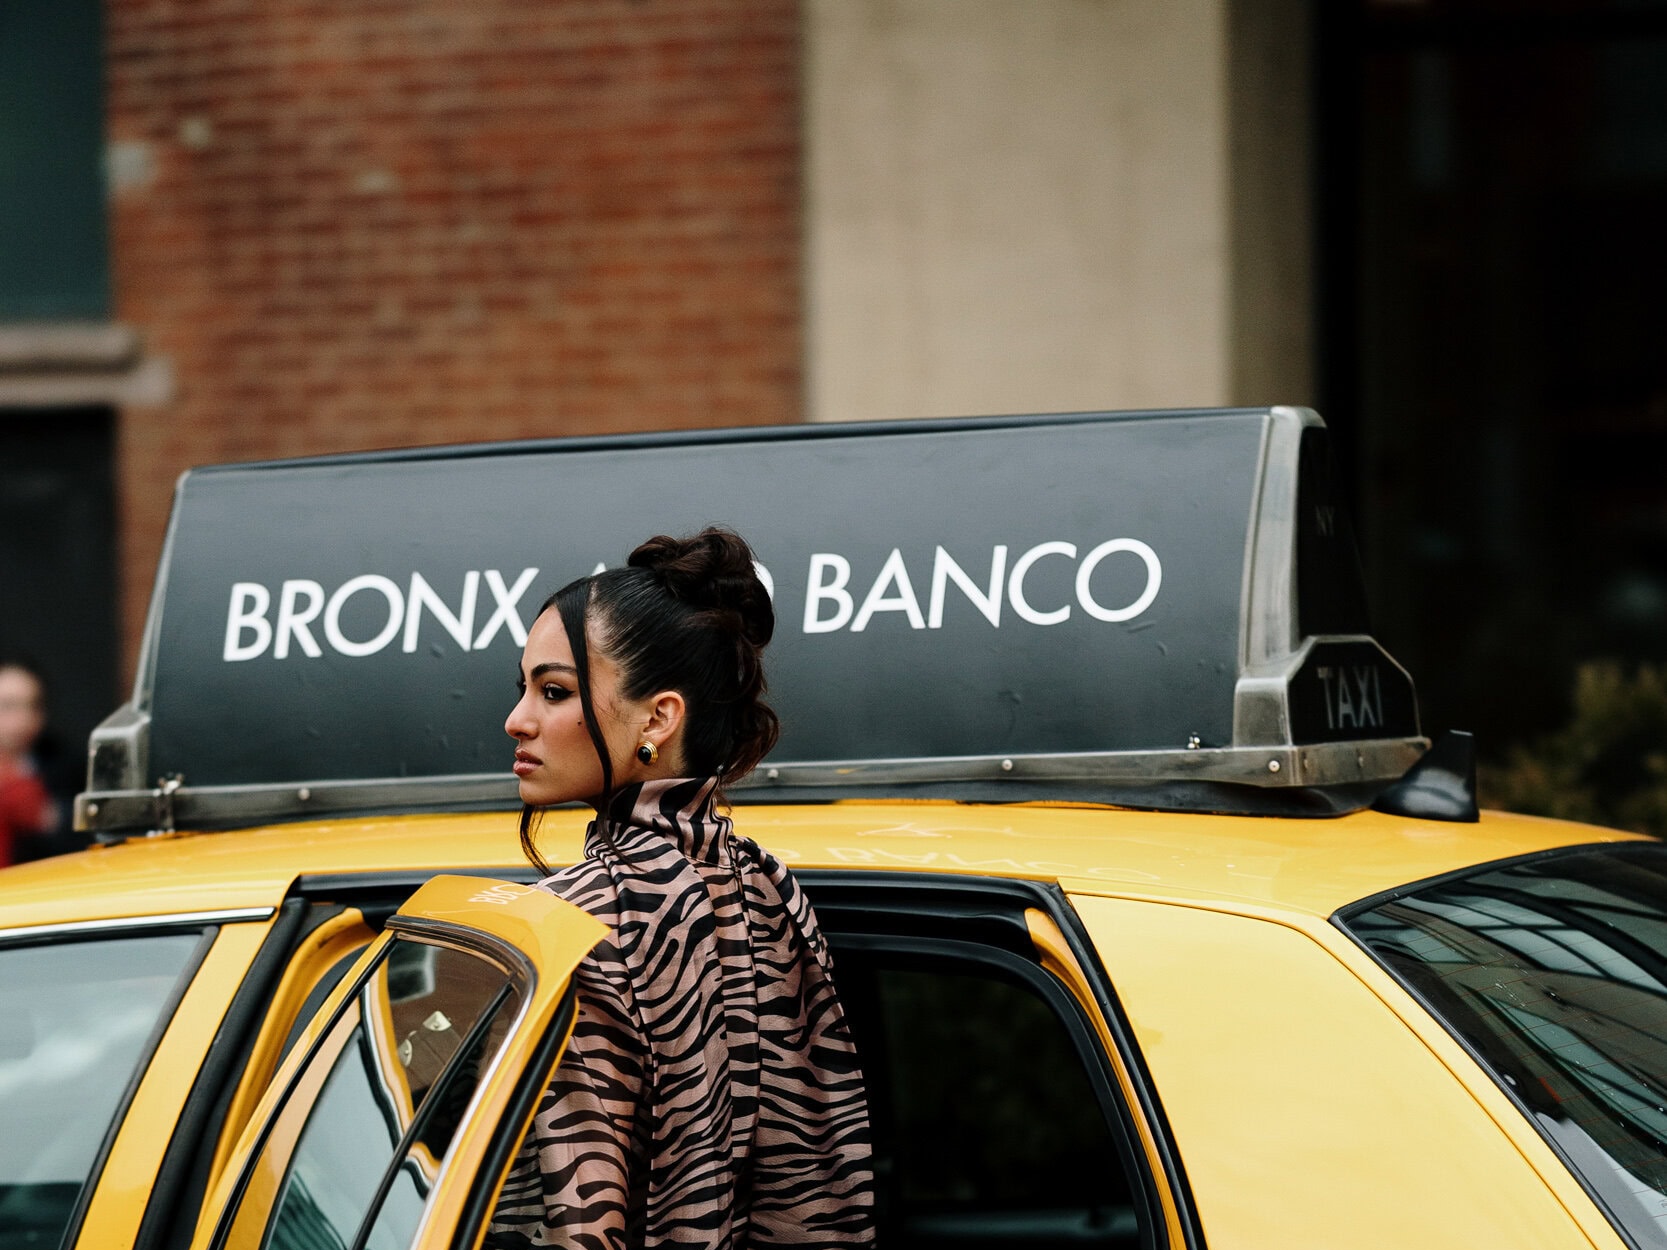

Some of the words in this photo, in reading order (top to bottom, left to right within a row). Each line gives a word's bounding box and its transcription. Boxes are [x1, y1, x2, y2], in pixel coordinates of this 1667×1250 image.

[223, 567, 540, 662] BRONX
[803, 537, 1163, 634] BANCO
[1317, 666, 1383, 729] TAXI
